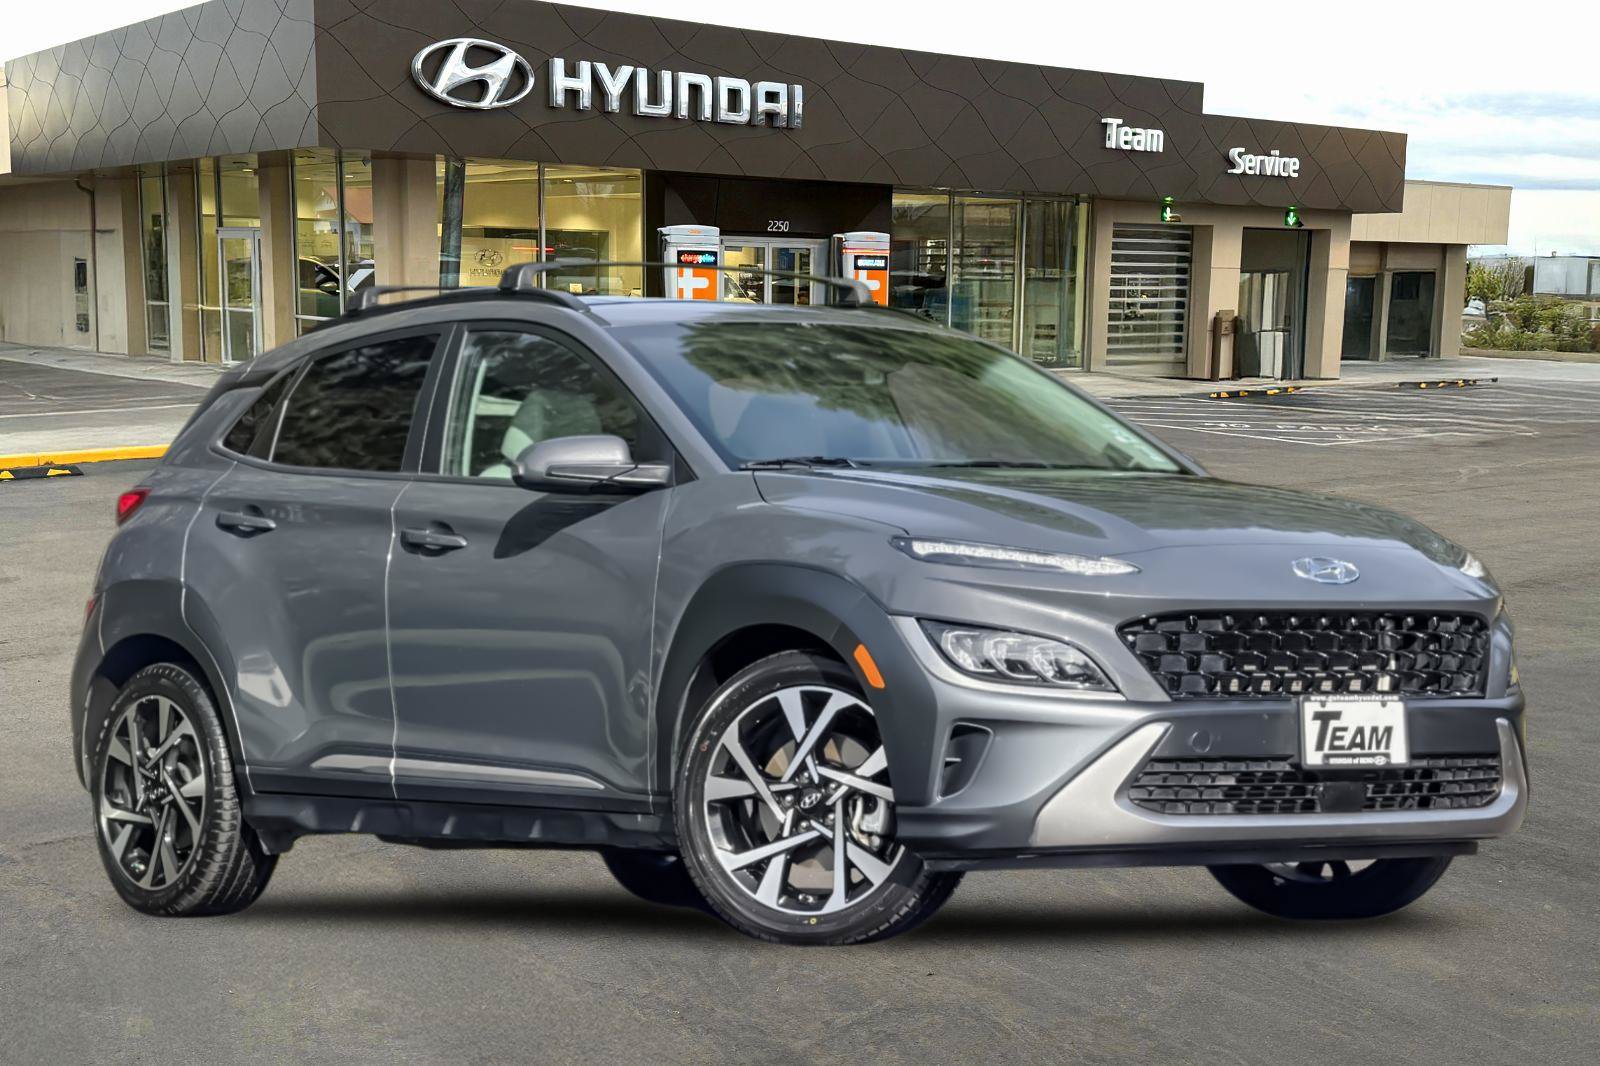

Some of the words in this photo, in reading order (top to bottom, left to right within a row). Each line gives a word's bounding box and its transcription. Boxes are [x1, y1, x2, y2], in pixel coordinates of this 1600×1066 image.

[548, 57, 803, 129] HYUNDAI
[1101, 117, 1164, 152] Team
[1227, 147, 1300, 178] Service
[767, 220, 790, 232] 2250
[1311, 710, 1394, 752] TEAM
